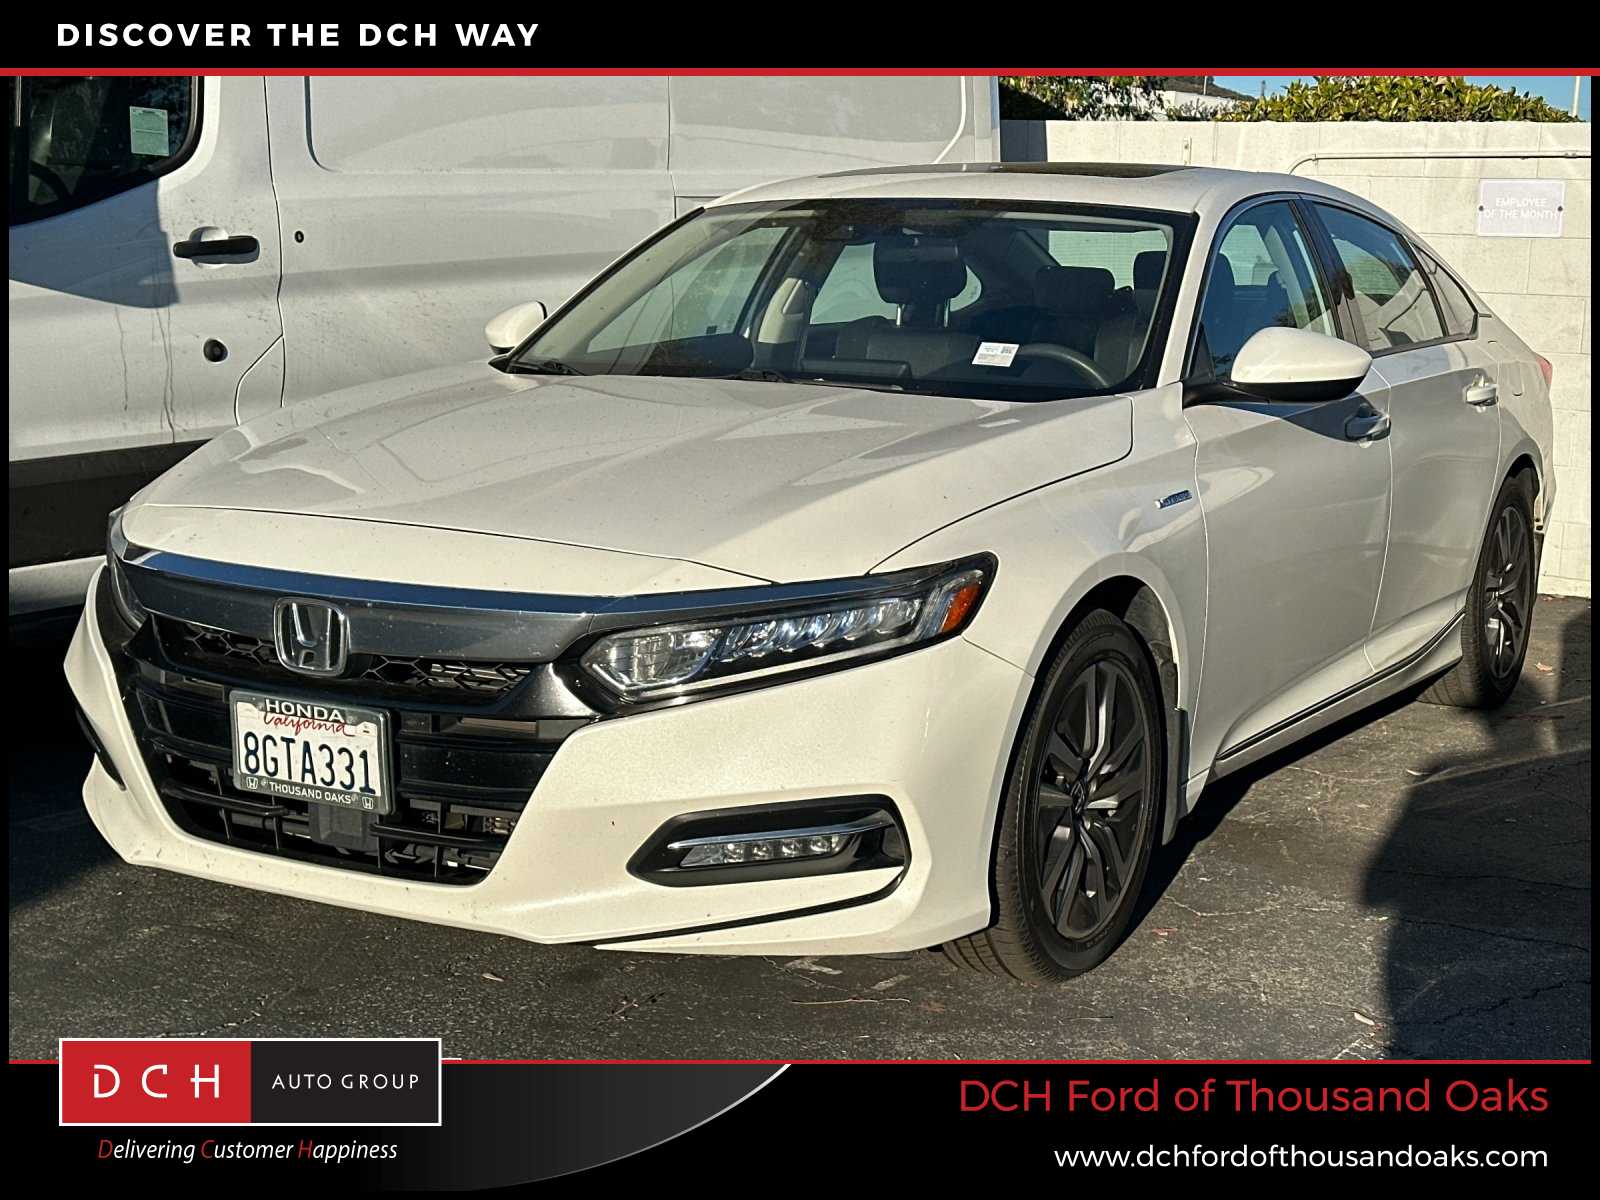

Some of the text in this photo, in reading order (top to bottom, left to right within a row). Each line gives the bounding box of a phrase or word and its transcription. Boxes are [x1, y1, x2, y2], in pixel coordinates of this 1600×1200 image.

[1483, 208, 1560, 219] OF THE MONTH
[1495, 197, 1548, 207] EMPLOYEE
[265, 699, 345, 723] HONDA
[263, 711, 356, 737] California
[243, 731, 376, 795] 8GTA331
[269, 781, 322, 799] THOUSAND
[324, 791, 351, 804] OAKS
